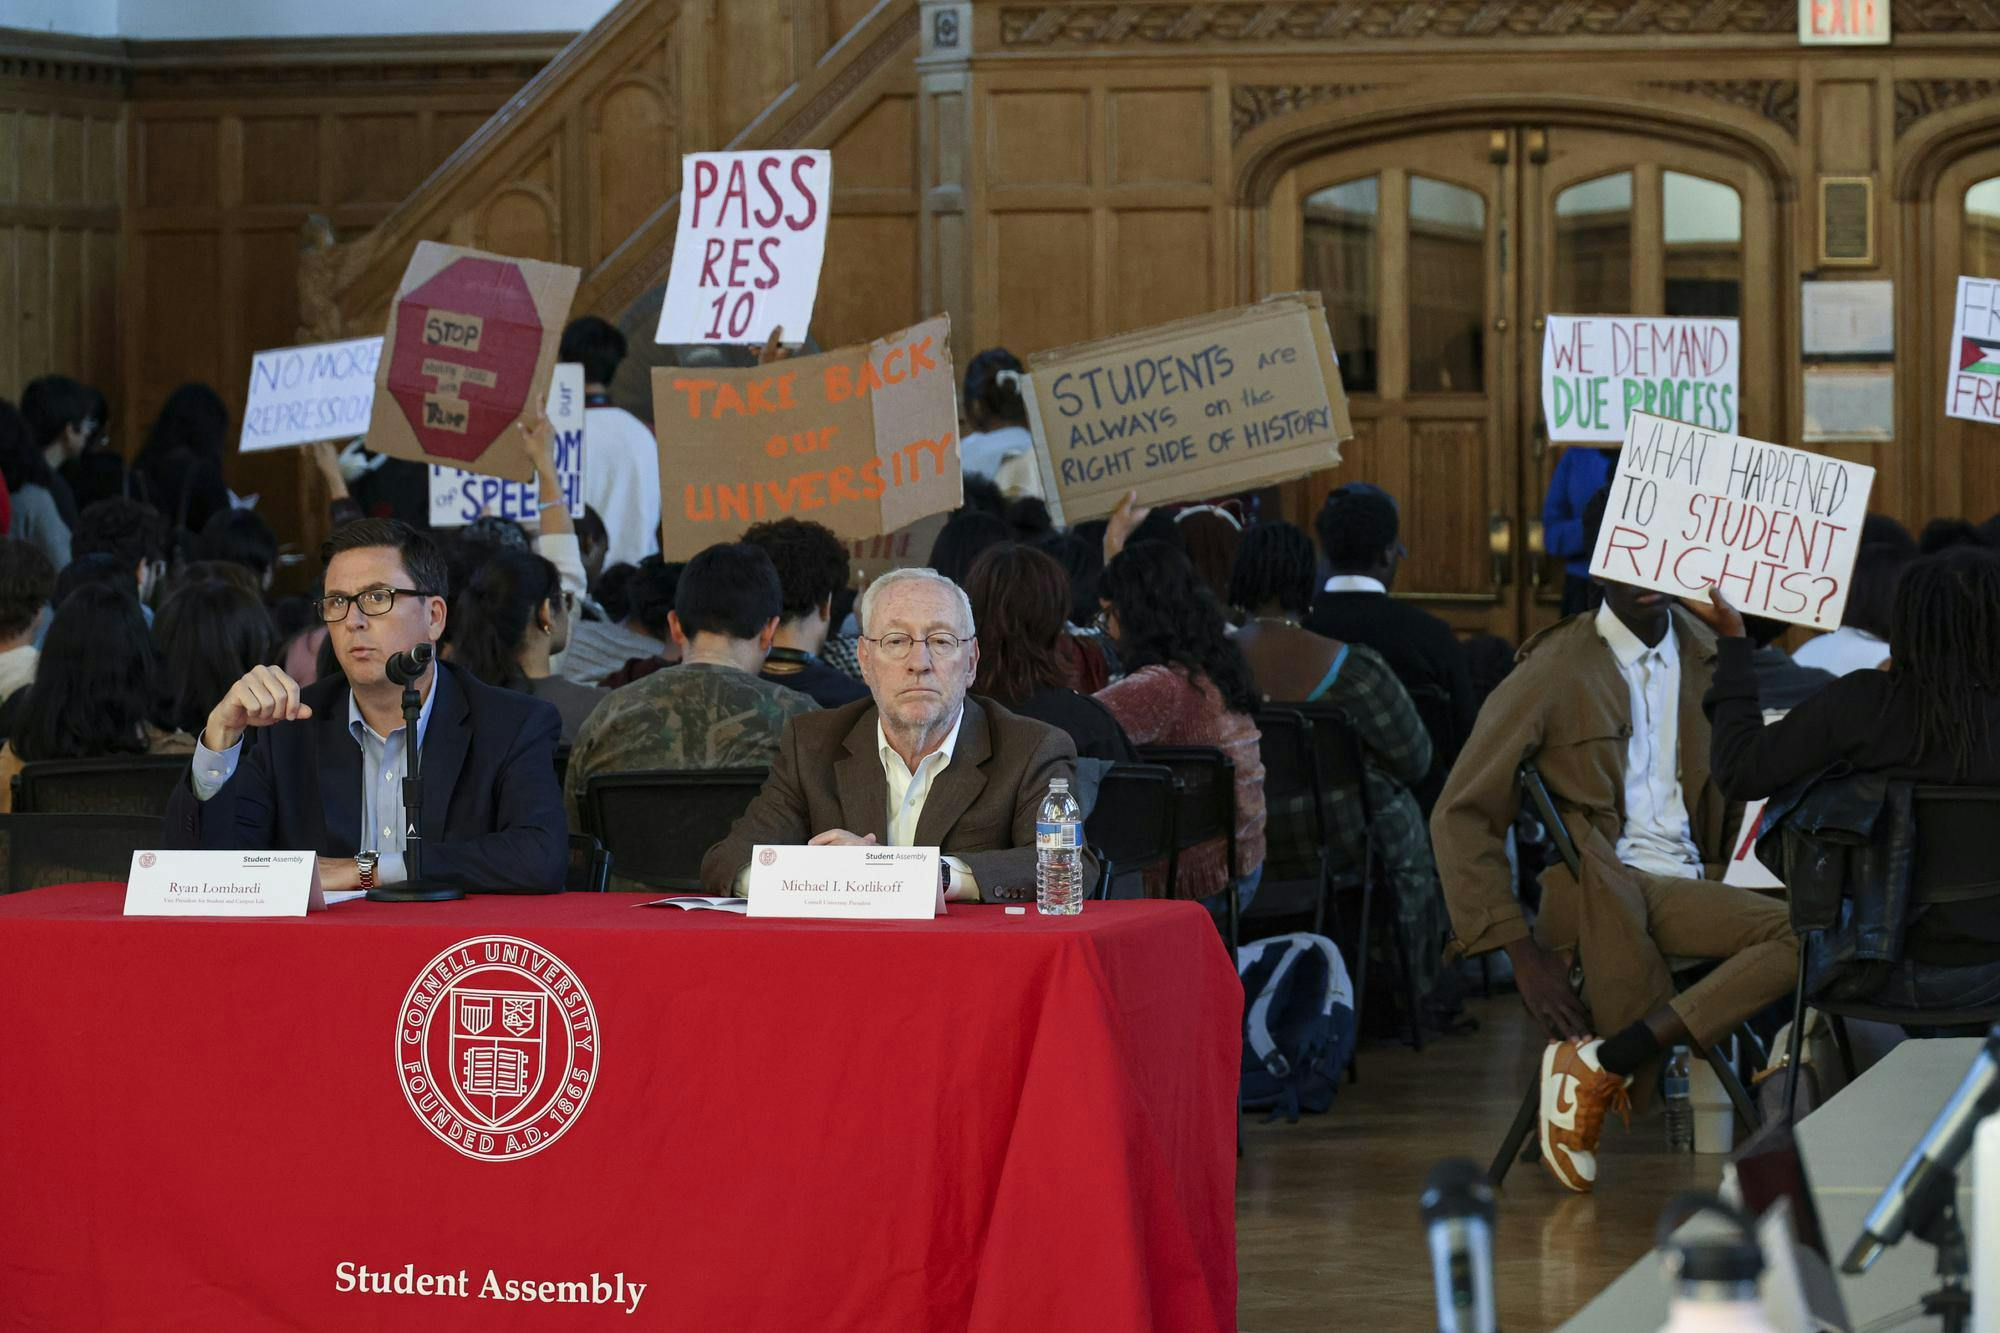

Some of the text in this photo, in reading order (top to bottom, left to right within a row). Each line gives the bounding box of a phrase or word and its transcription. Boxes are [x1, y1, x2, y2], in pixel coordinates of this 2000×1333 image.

[1810, 0, 1875, 35] EXIT
[691, 156, 817, 231] PASS
[699, 237, 781, 289] RES
[427, 318, 479, 346] STOP
[704, 292, 754, 339] 10
[254, 352, 304, 394] NO
[672, 335, 936, 419] TAKE BACK
[1550, 321, 1728, 377] WE DEMAND
[1053, 344, 1235, 417] STUDENTS
[1553, 375, 1732, 433] DUE PROCESS
[763, 426, 839, 457] our
[1061, 405, 1330, 486] RIGHT SIDE OF HISTORY
[1070, 388, 1274, 449] ALWAYS on the
[684, 431, 953, 522] UNIVERSITY
[1628, 414, 1848, 517] WHAT HAPPENED
[461, 474, 580, 521] SPEEH!
[1622, 474, 1847, 572] TO STUDENT
[1603, 525, 1838, 622] RIGHTS?
[272, 856, 304, 864] Assembly
[895, 853, 927, 862] Assembly
[169, 882, 261, 895] Ryan Lombardi
[781, 880, 904, 893] Michael I. Kotlikoff
[404, 944, 592, 1051] CORNELL UNIVERSITY
[405, 1061, 590, 1153] FOUNDED A.D. 1865
[335, 1261, 648, 1314] Student Assembly
